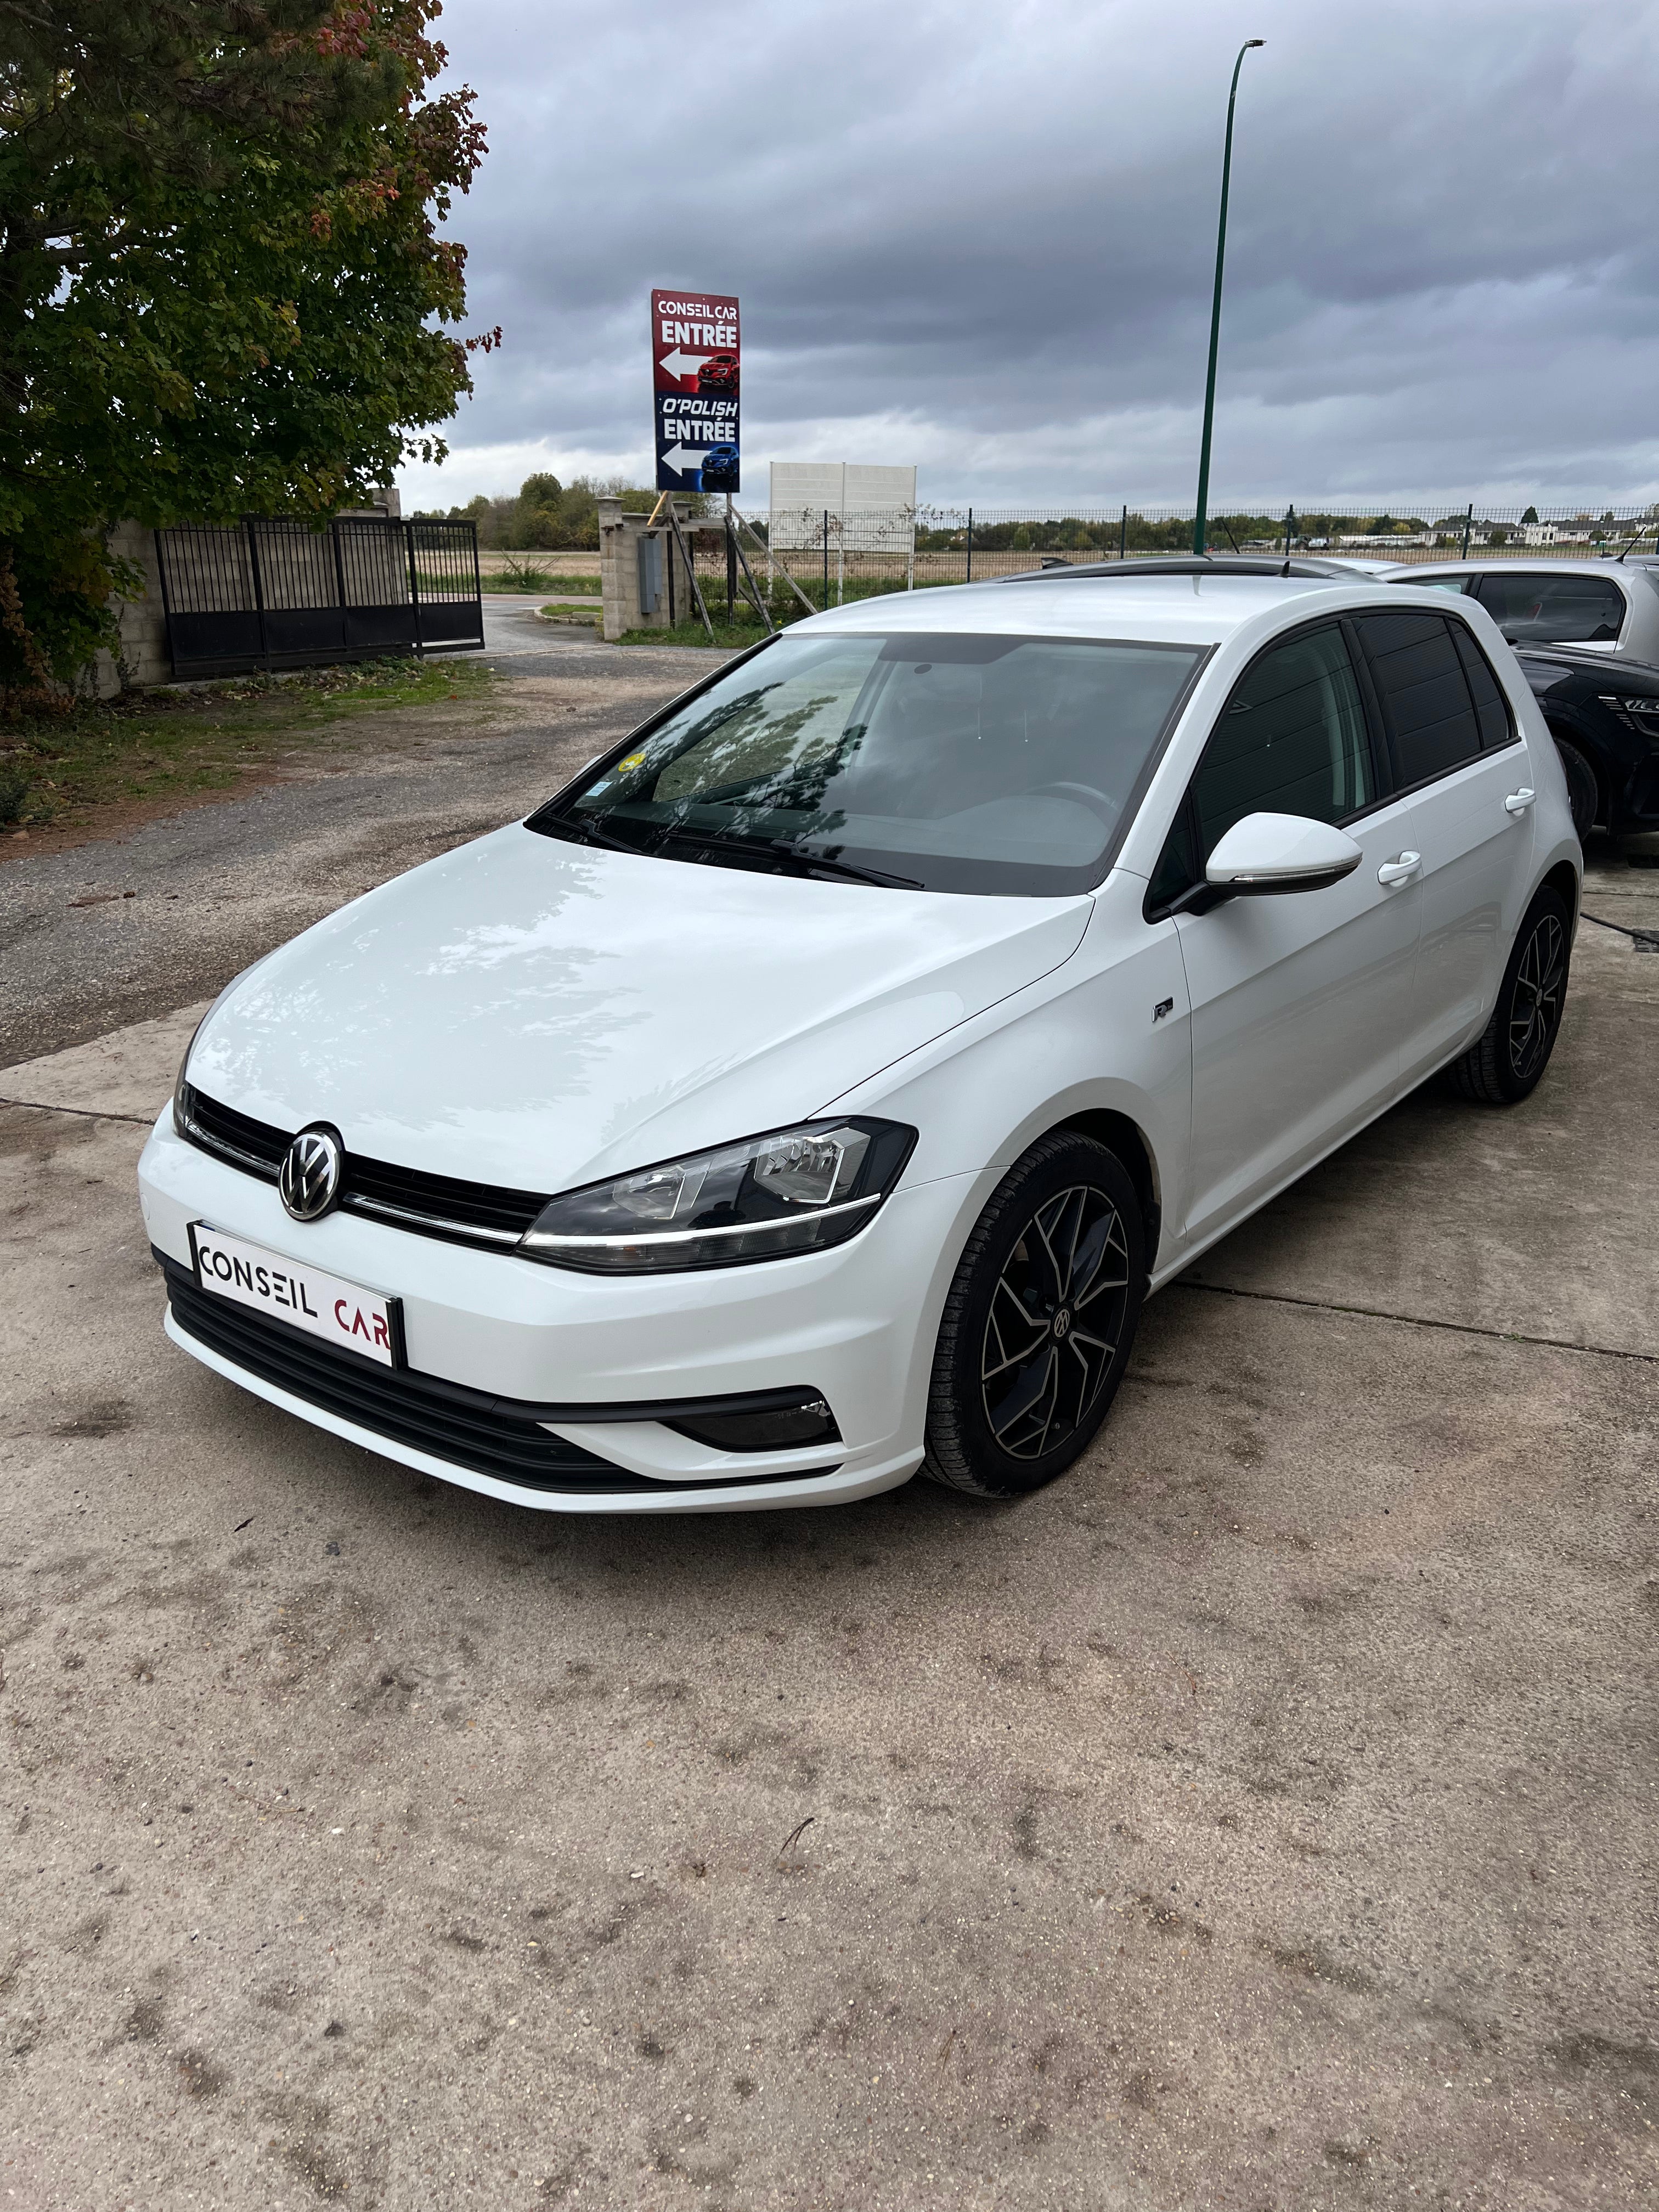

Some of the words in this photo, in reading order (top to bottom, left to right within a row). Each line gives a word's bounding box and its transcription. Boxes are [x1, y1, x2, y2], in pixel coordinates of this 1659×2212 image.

[658, 300, 714, 319] CONSEIL
[714, 306, 737, 320] CAR
[661, 320, 737, 348] ENTRÉE
[662, 397, 738, 417] O'POLISH
[663, 417, 736, 443] ENTRÉE
[199, 1245, 319, 1318] CONSEIL
[334, 1299, 391, 1350] CAR
